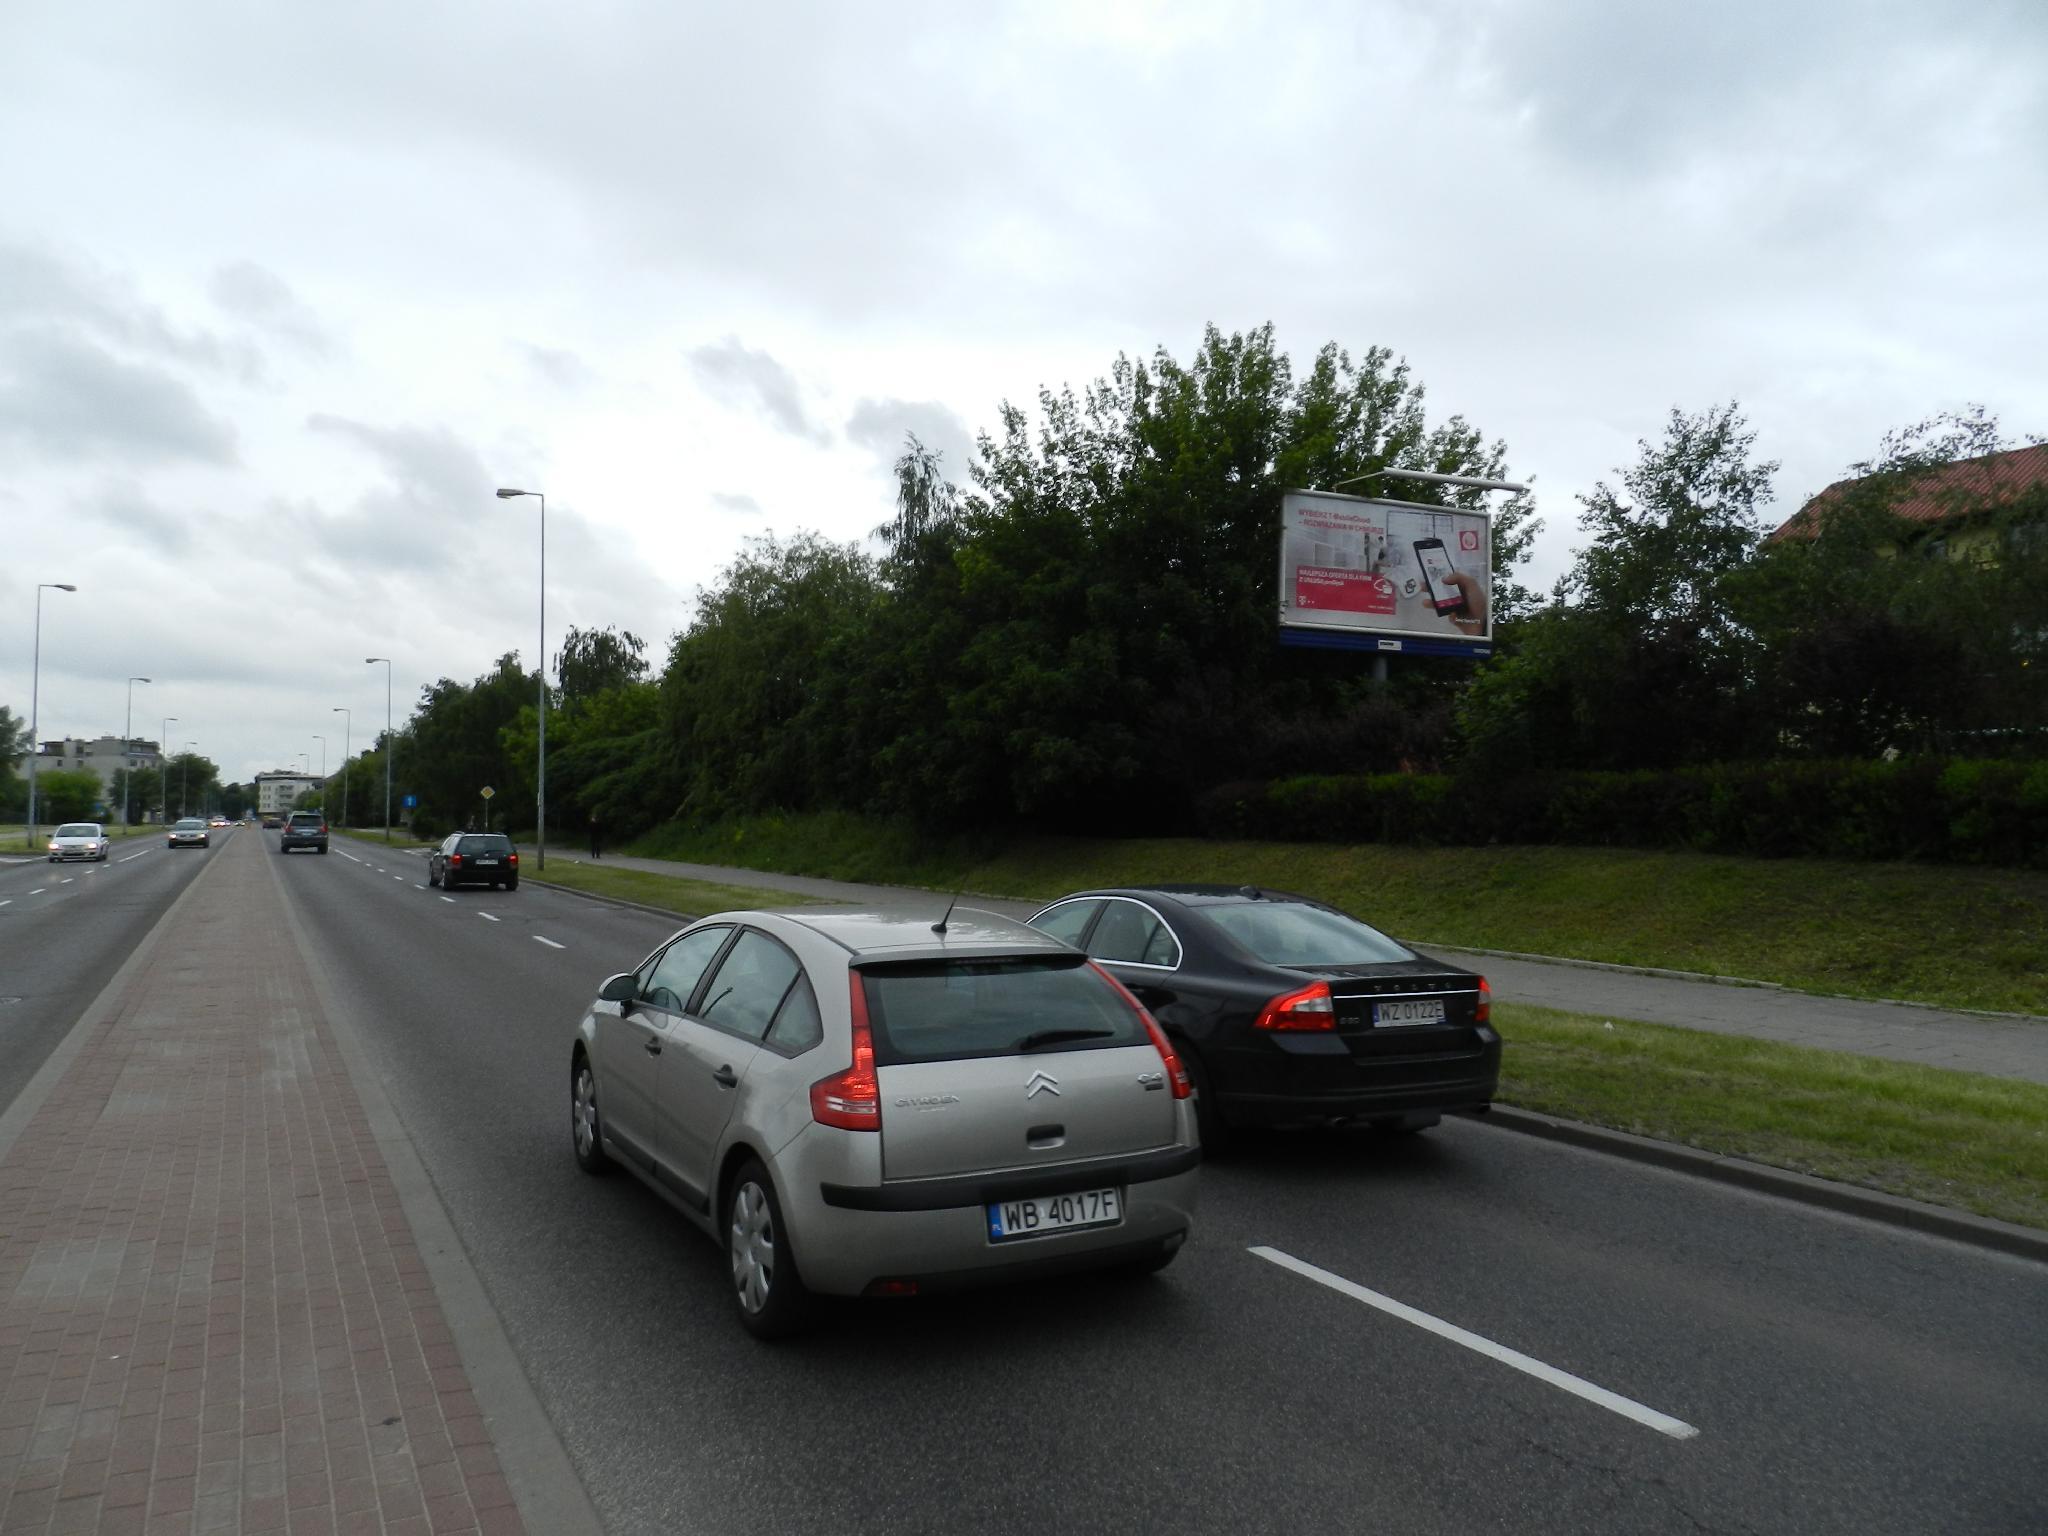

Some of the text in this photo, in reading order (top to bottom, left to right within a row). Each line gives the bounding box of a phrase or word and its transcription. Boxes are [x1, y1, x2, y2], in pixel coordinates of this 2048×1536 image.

[1381, 1001, 1442, 1020] WZ 0122E
[1005, 1190, 1114, 1231] WB 4017F
